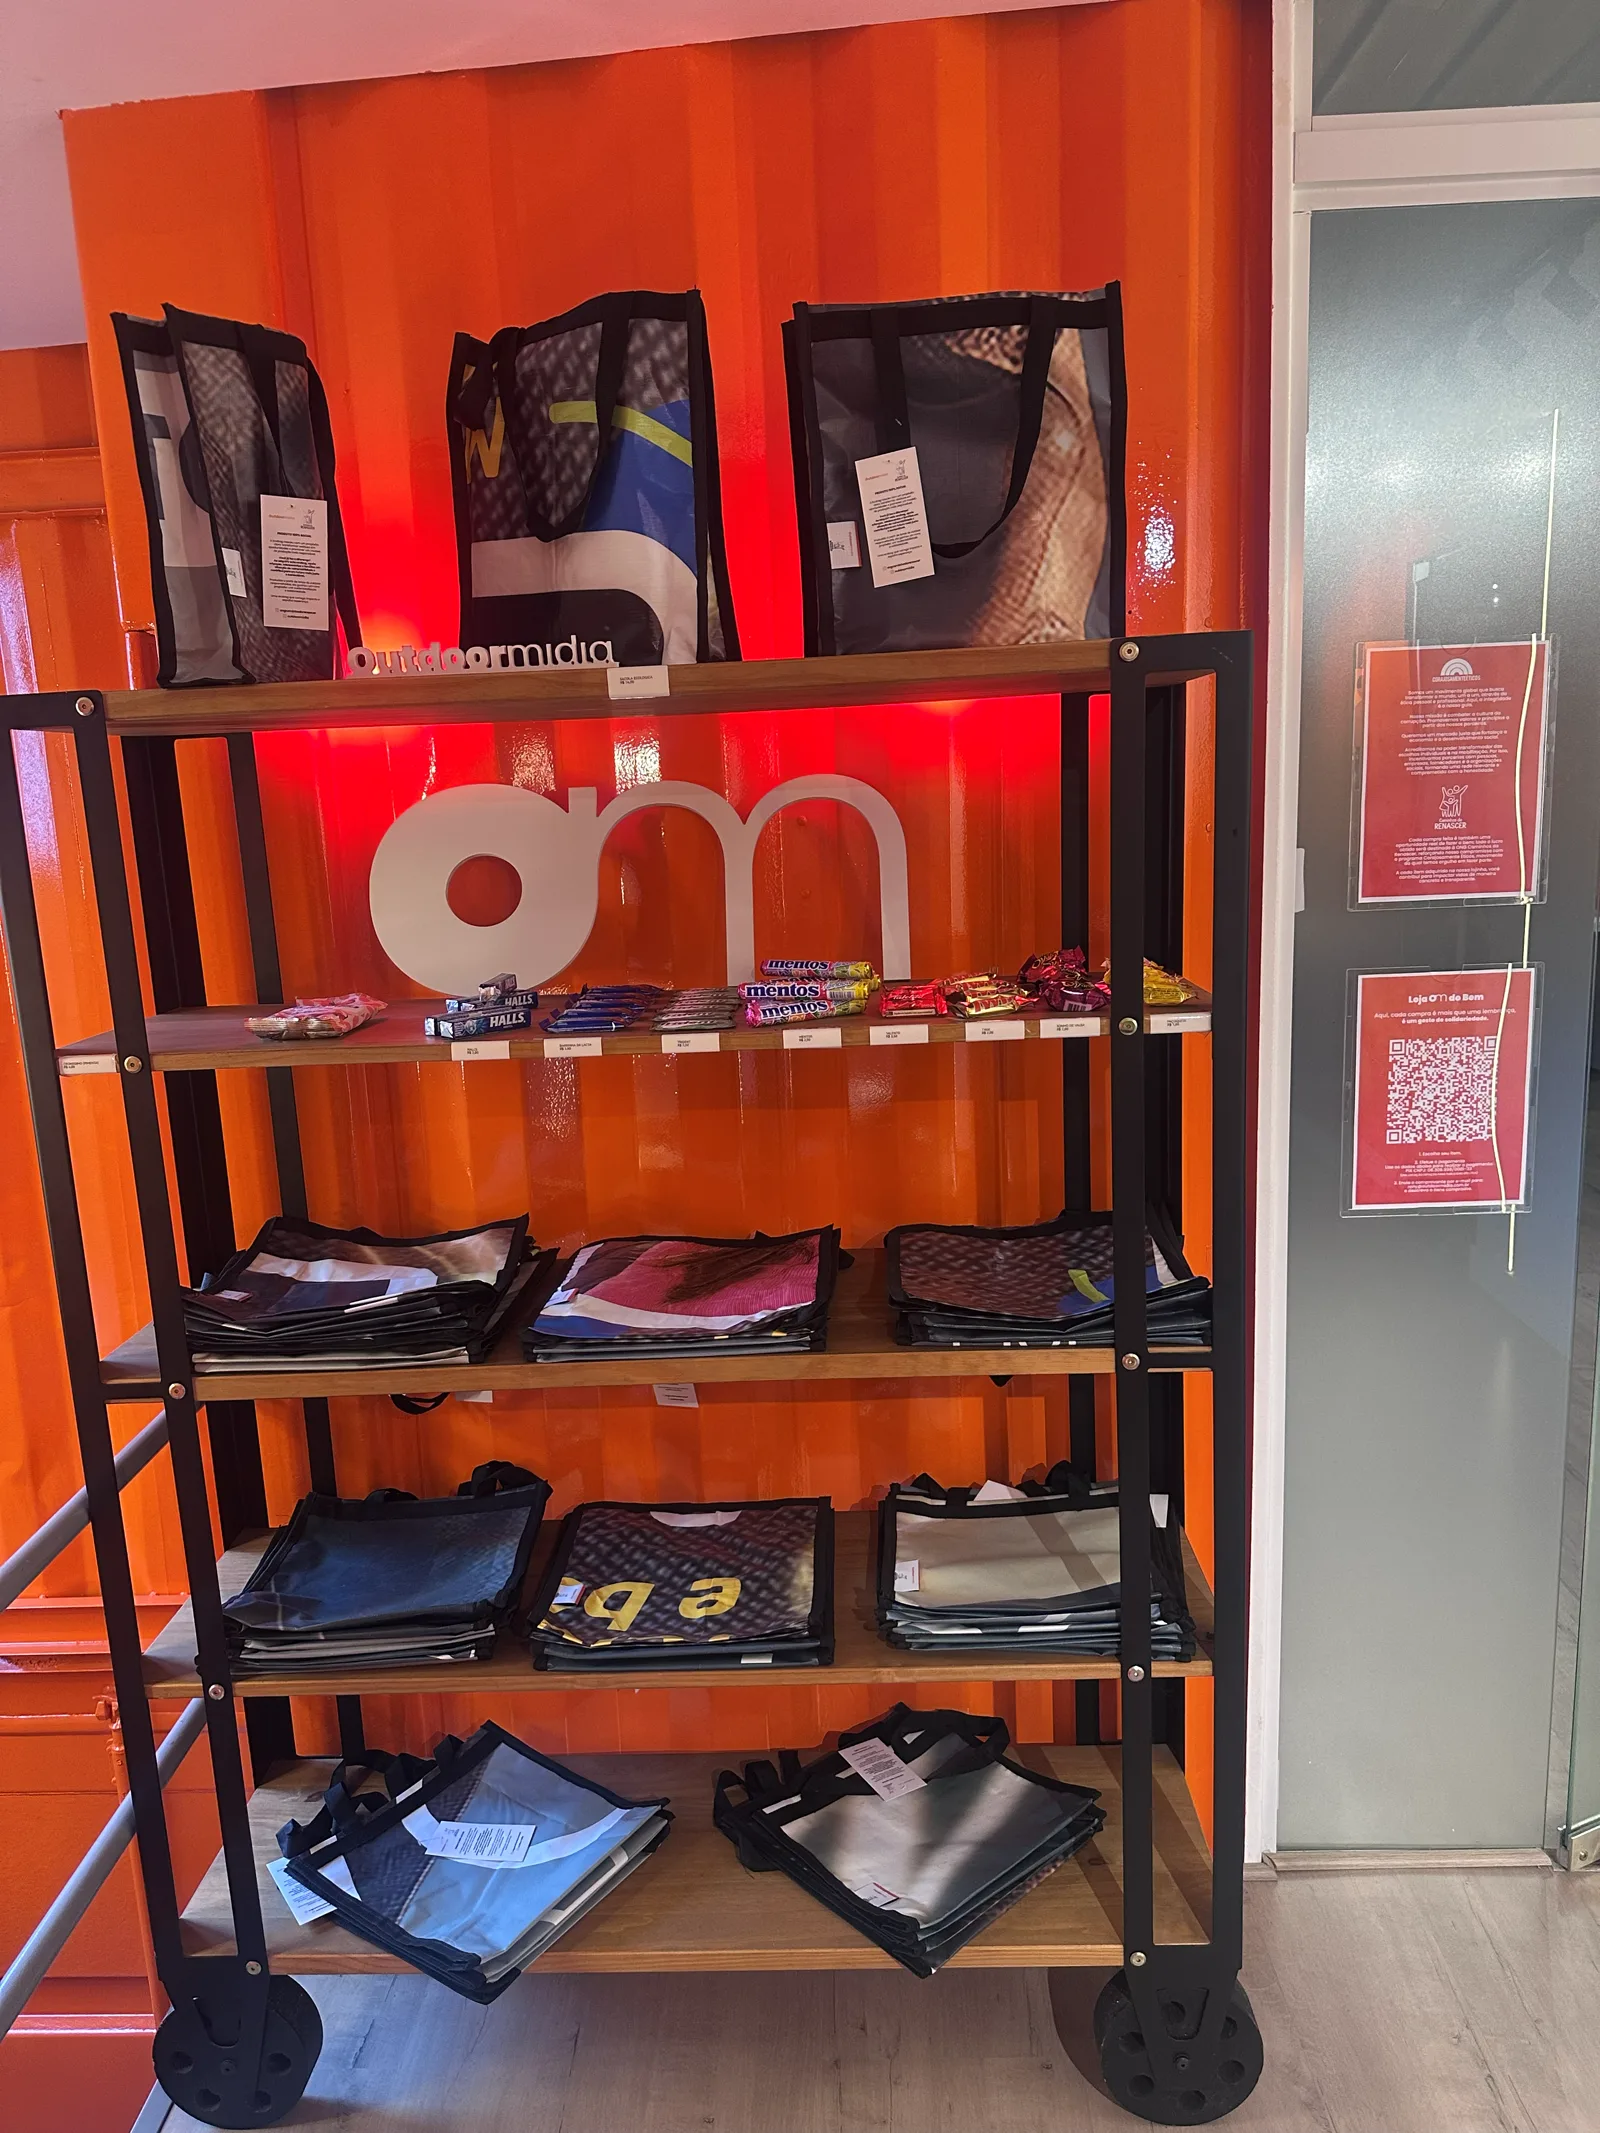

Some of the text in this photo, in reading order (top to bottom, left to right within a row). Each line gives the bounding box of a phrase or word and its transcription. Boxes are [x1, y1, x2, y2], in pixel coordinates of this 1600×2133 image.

[348, 635, 616, 676] outdoormidia
[767, 959, 829, 969] mentos
[745, 983, 820, 997] mentos
[1409, 994, 1428, 1005] Loja
[1463, 992, 1484, 1001] Bem
[759, 1000, 828, 1018] mentos
